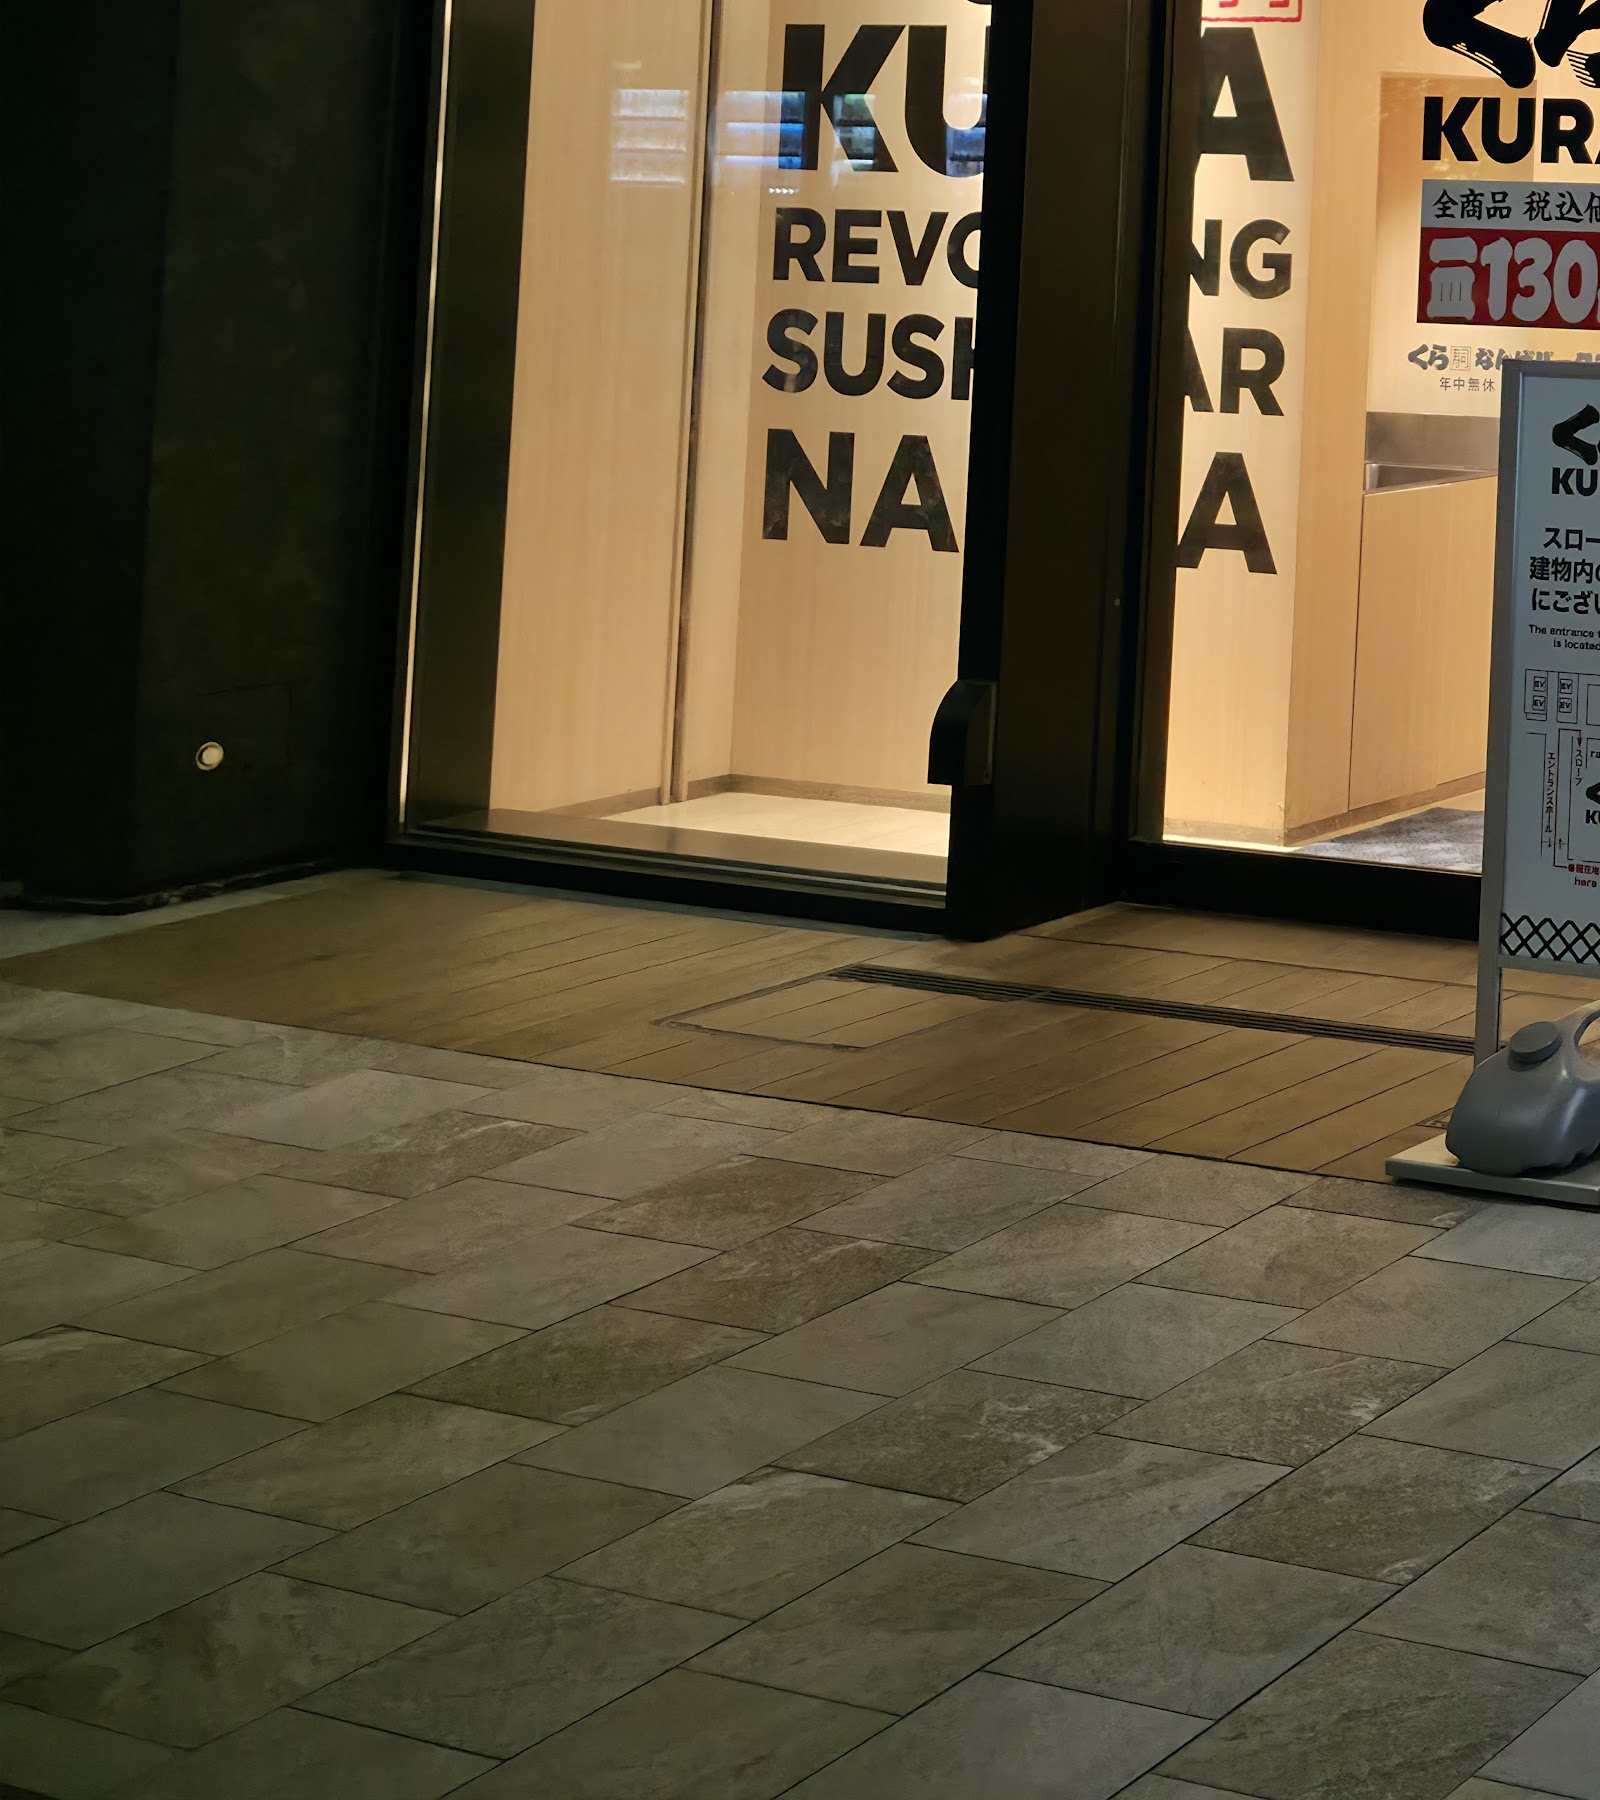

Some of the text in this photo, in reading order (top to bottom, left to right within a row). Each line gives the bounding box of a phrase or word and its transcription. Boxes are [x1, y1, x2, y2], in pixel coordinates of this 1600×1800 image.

[778, 23, 1294, 181] KUA
[1432, 188, 1512, 221] 全商品
[1407, 343, 1450, 370] くら
[1439, 376, 1496, 393] 年中無休
[762, 429, 1278, 575] NAA
[1529, 624, 1547, 635] The
[1550, 627, 1595, 639] entrance
[1553, 638, 1562, 648] is
[1574, 877, 1597, 888] here
